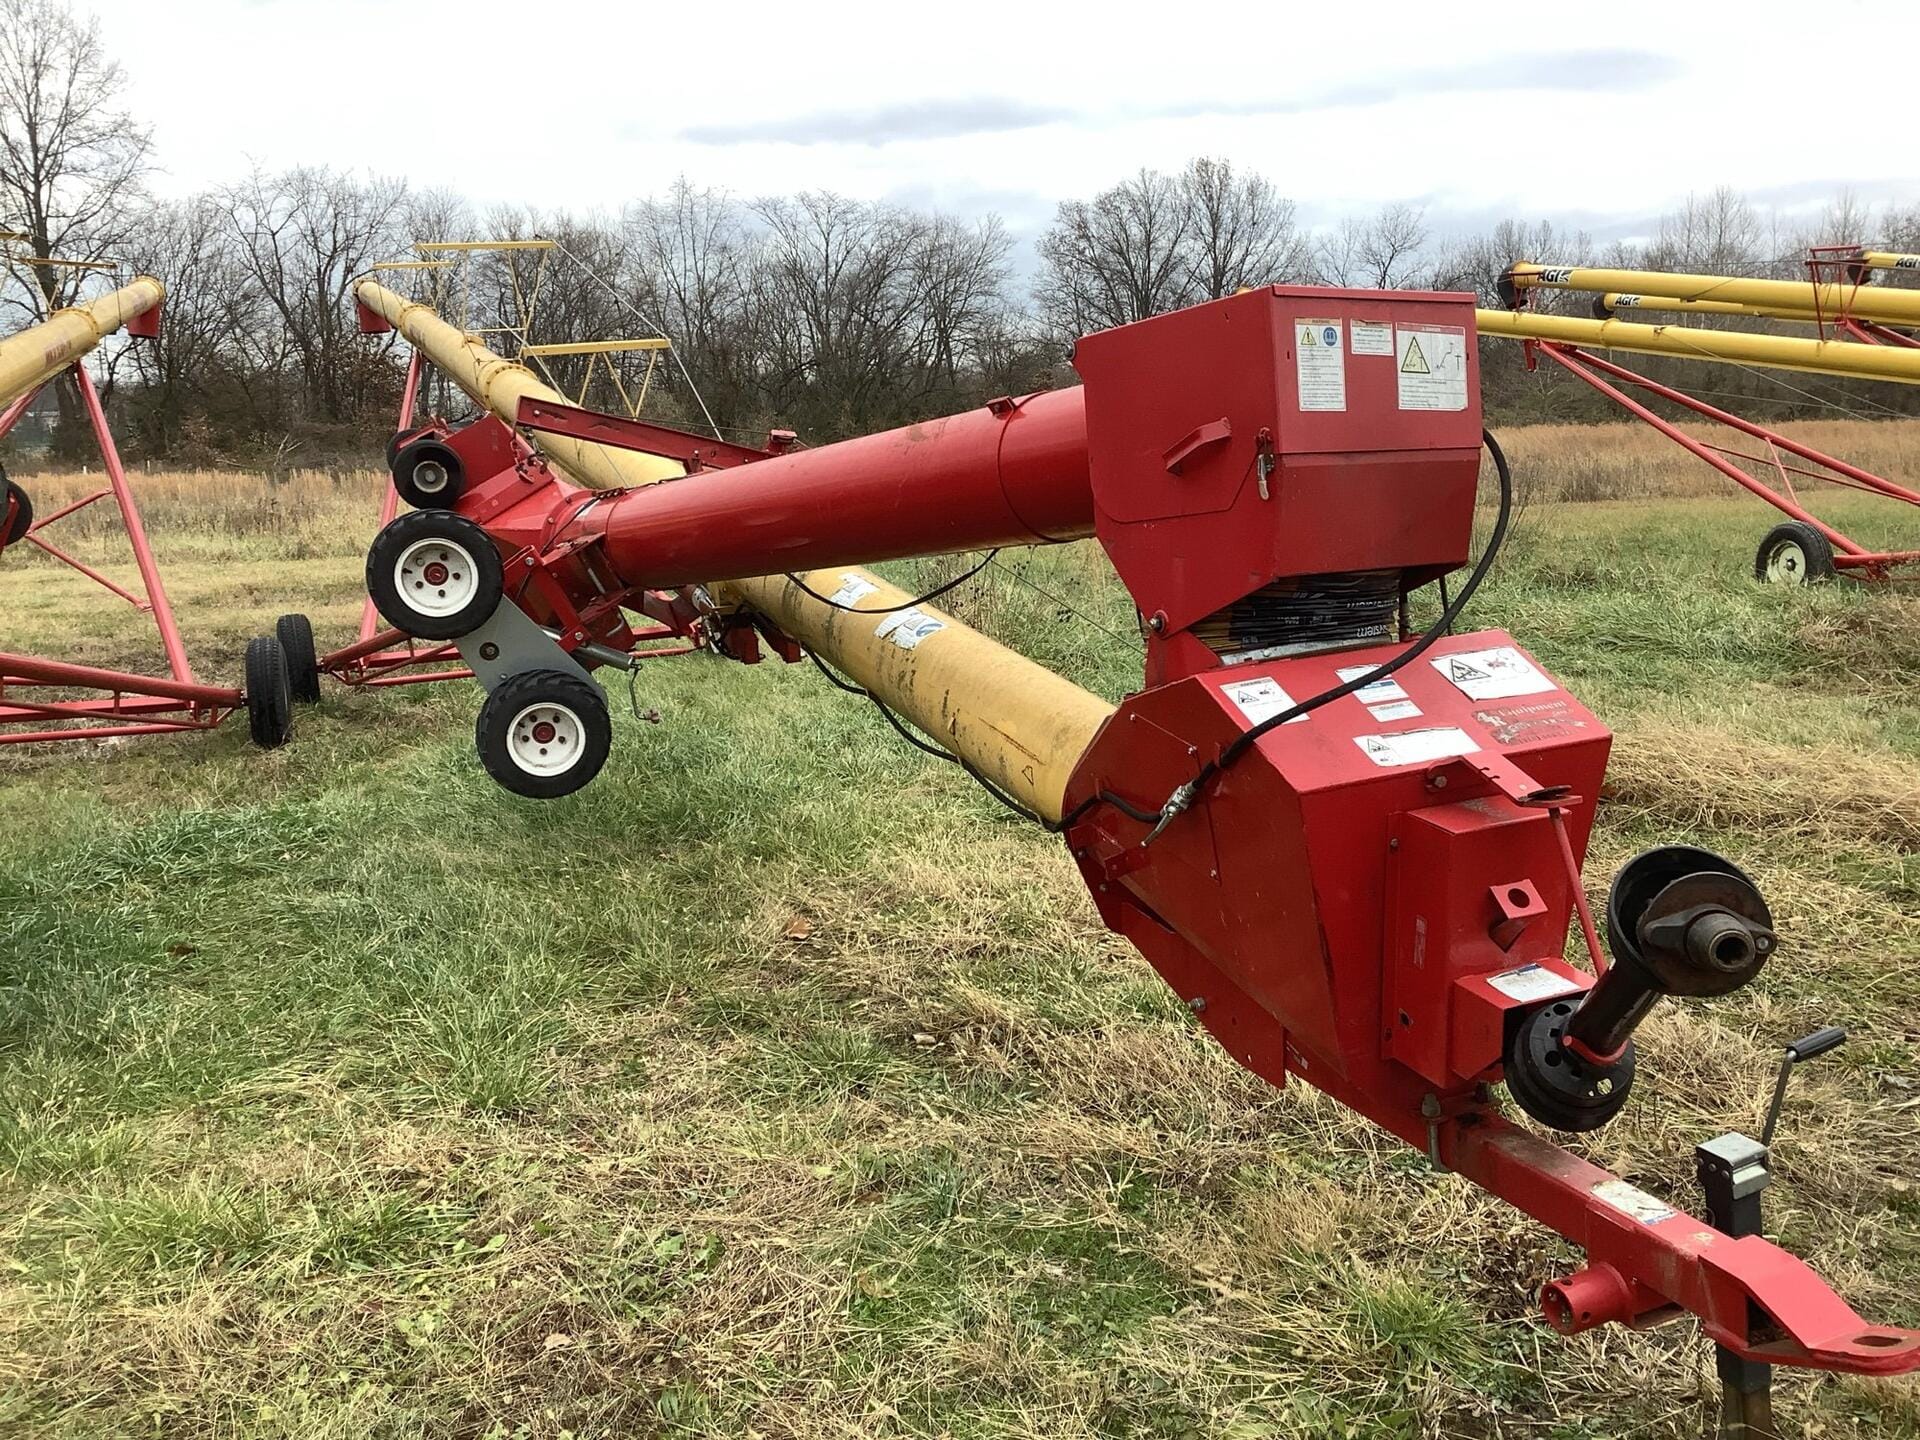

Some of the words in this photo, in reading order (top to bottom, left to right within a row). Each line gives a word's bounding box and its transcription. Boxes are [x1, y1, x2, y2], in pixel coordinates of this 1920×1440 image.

[1895, 258, 1918, 268] AGI
[1537, 269, 1561, 282] AGI
[1614, 295, 1633, 306] AGI
